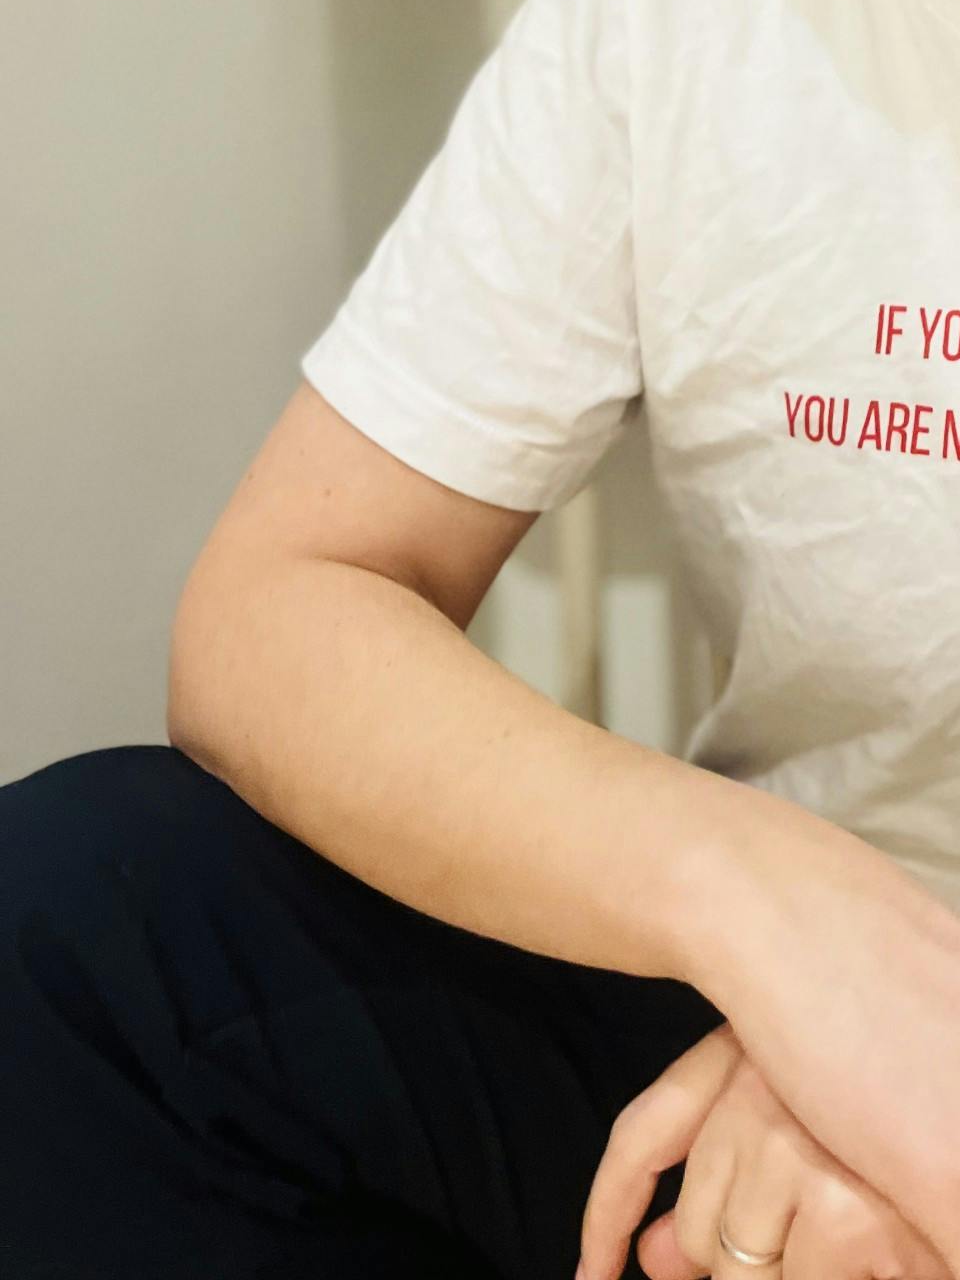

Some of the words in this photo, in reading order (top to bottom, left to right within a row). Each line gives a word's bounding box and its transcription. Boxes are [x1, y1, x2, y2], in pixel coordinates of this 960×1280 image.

[875, 303, 908, 356] IF
[784, 392, 850, 448] YOU
[857, 399, 935, 457] ARE
